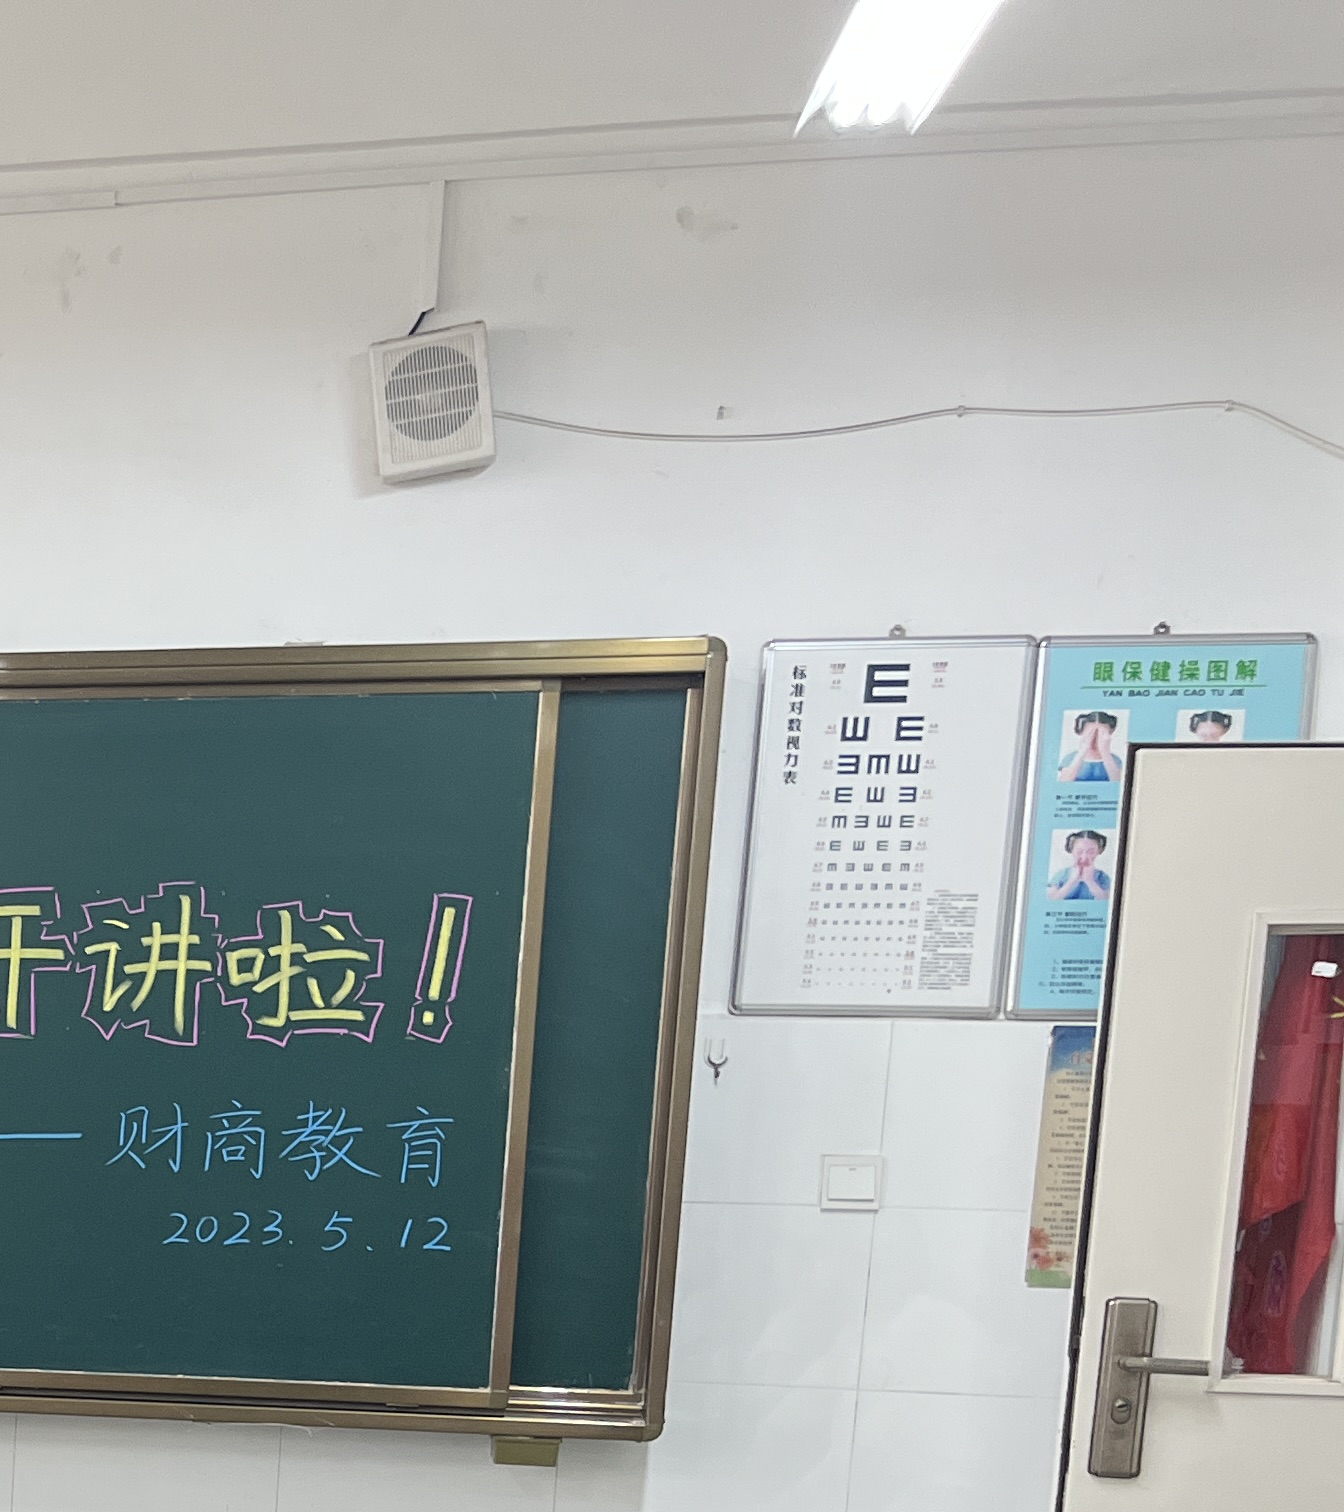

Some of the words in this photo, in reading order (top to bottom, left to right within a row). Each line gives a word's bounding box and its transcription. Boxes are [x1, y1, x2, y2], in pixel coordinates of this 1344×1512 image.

[1092, 660, 1258, 684] 眼保健操图解
[1102, 689, 1123, 698] YAN
[1128, 689, 1151, 698] BAO
[1155, 689, 1179, 698] JIAN
[1183, 688, 1206, 697] CAO
[1211, 688, 1225, 697] TU
[1229, 688, 1245, 697] JIE
[783, 664, 808, 786] 标准对数视力表
